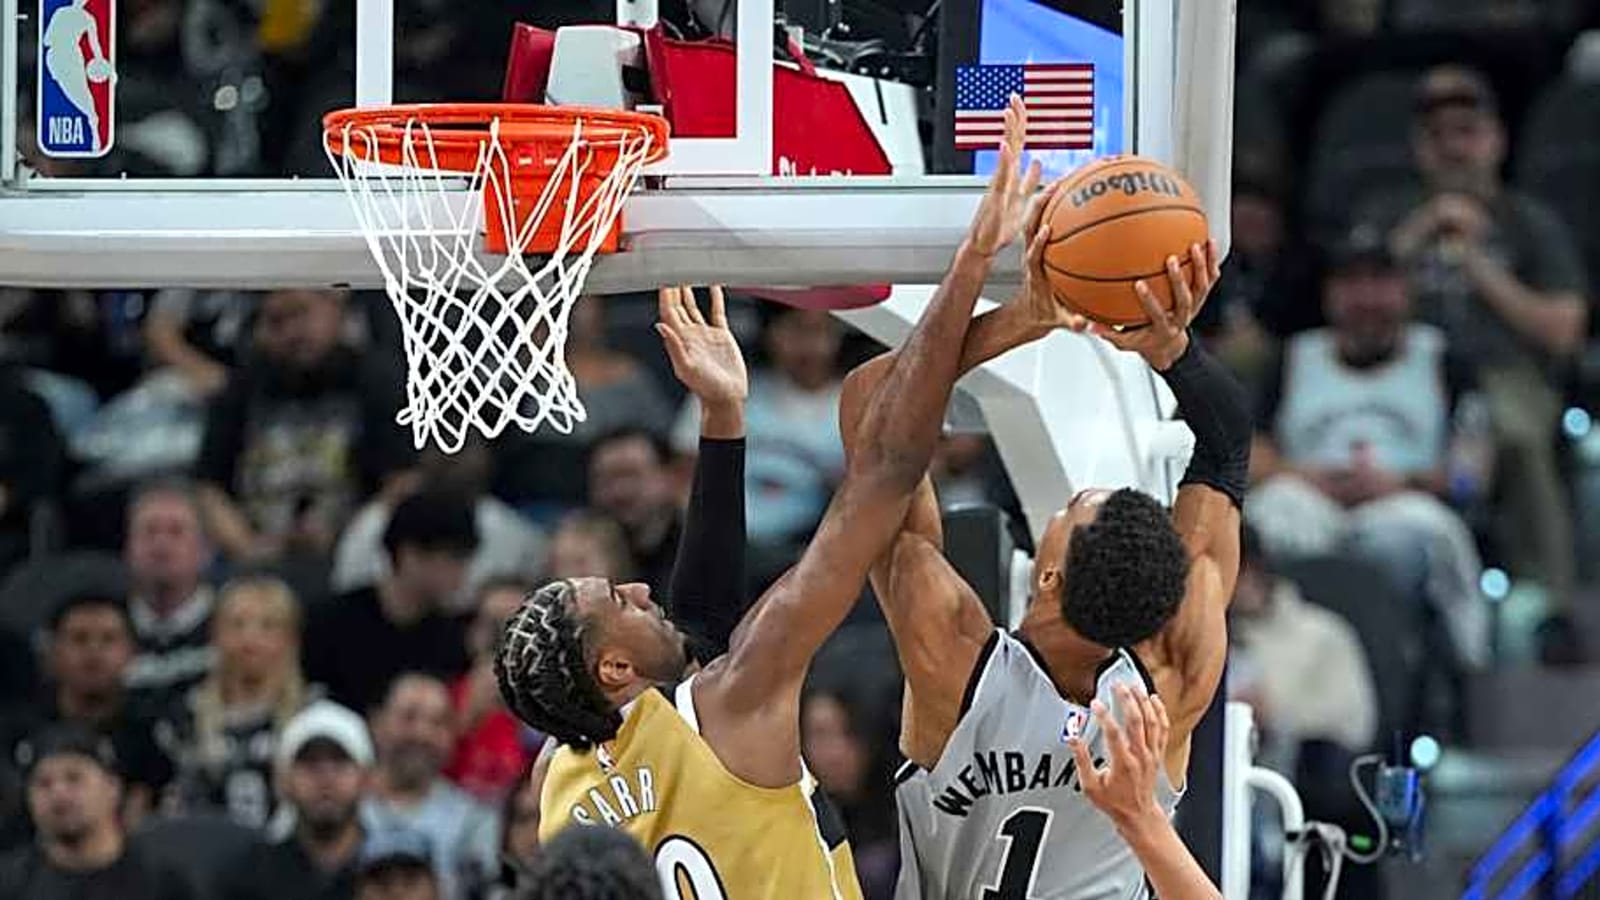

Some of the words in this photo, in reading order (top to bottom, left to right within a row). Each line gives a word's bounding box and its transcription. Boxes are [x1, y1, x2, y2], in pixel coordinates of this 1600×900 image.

[48, 116, 85, 145] NBA
[1072, 171, 1181, 207] Wilson
[571, 766, 656, 827] SARR
[932, 751, 1104, 817] WEMBAN
[979, 806, 1054, 900] 1
